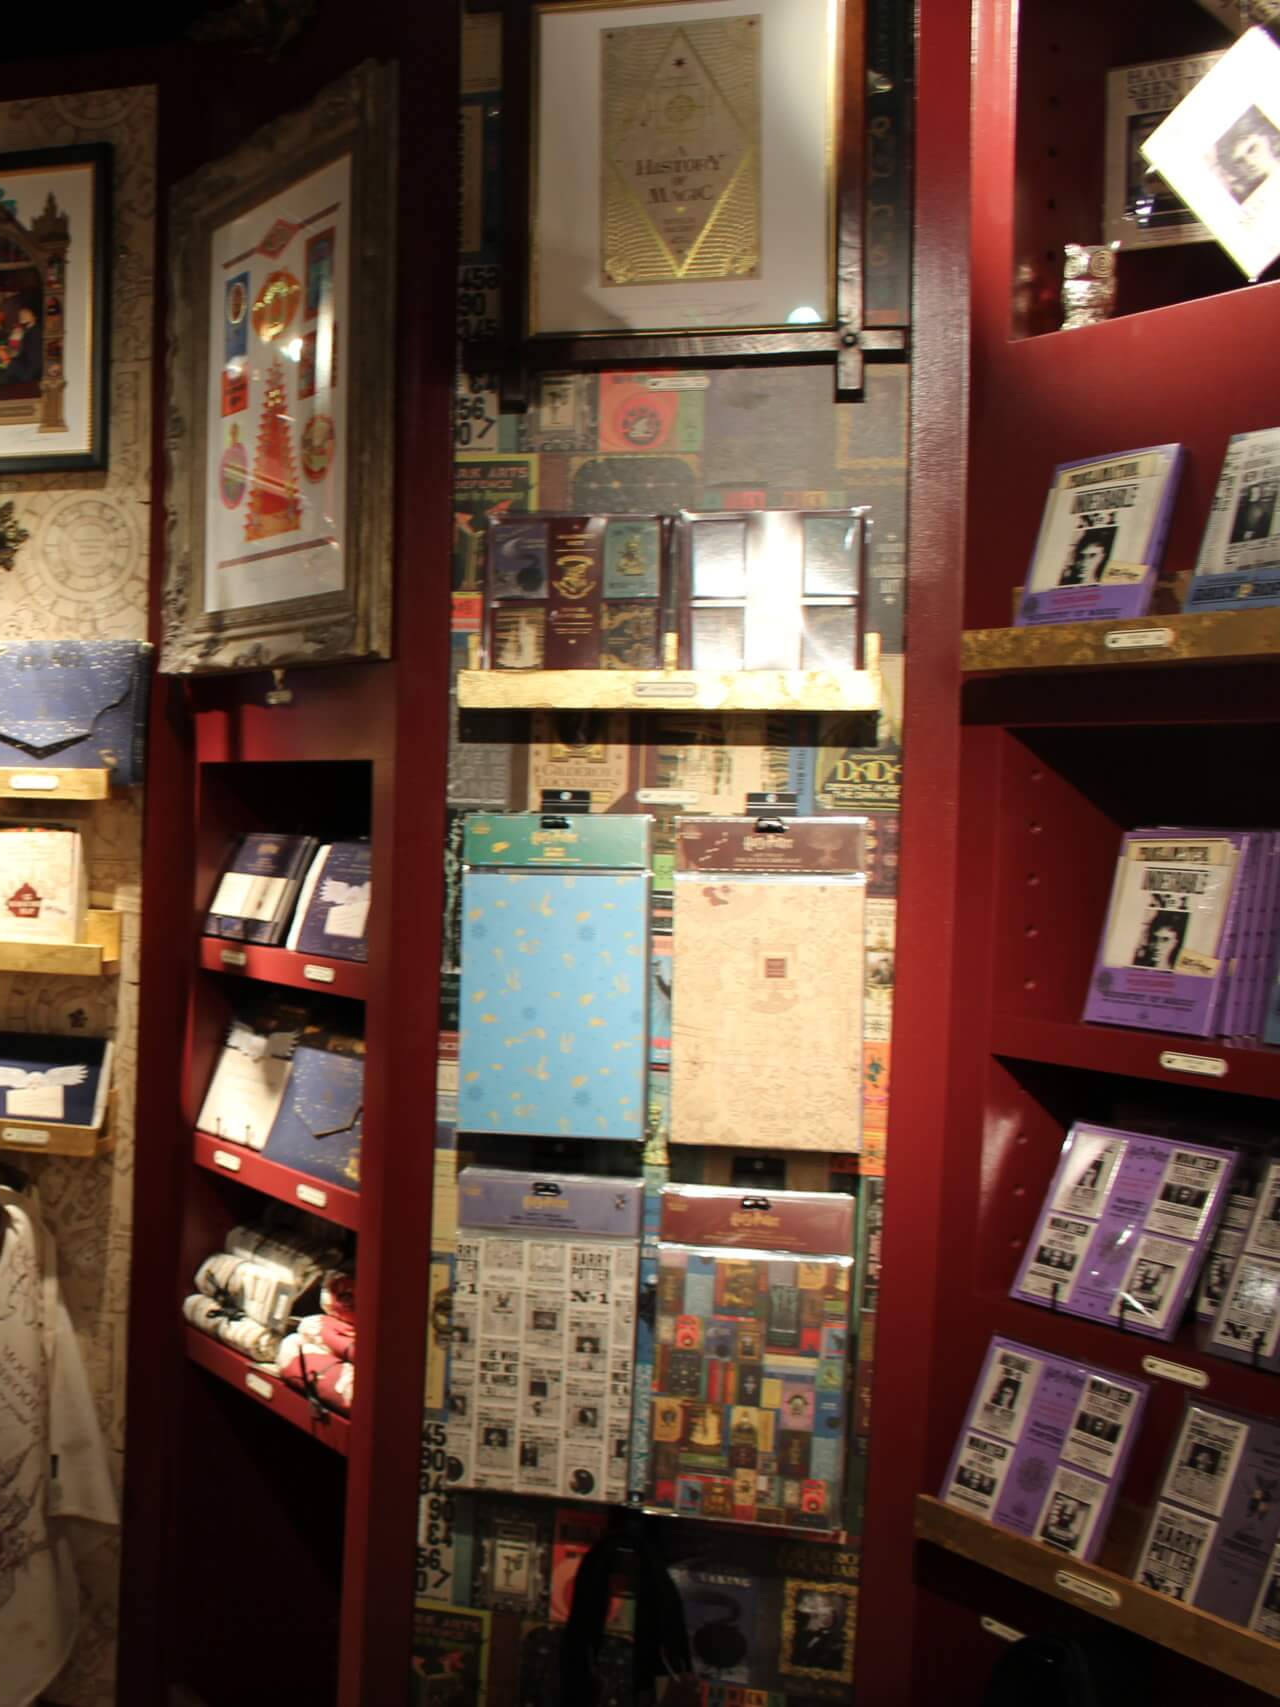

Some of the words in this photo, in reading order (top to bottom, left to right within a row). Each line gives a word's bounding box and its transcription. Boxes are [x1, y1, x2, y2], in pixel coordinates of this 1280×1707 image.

[1127, 62, 1182, 84] HAVE
[1127, 80, 1180, 99] SEEN
[634, 154, 728, 176] HISTORY
[646, 184, 715, 204] MAGIC
[571, 1252, 612, 1268] HARRY
[570, 1267, 610, 1282] POTTER
